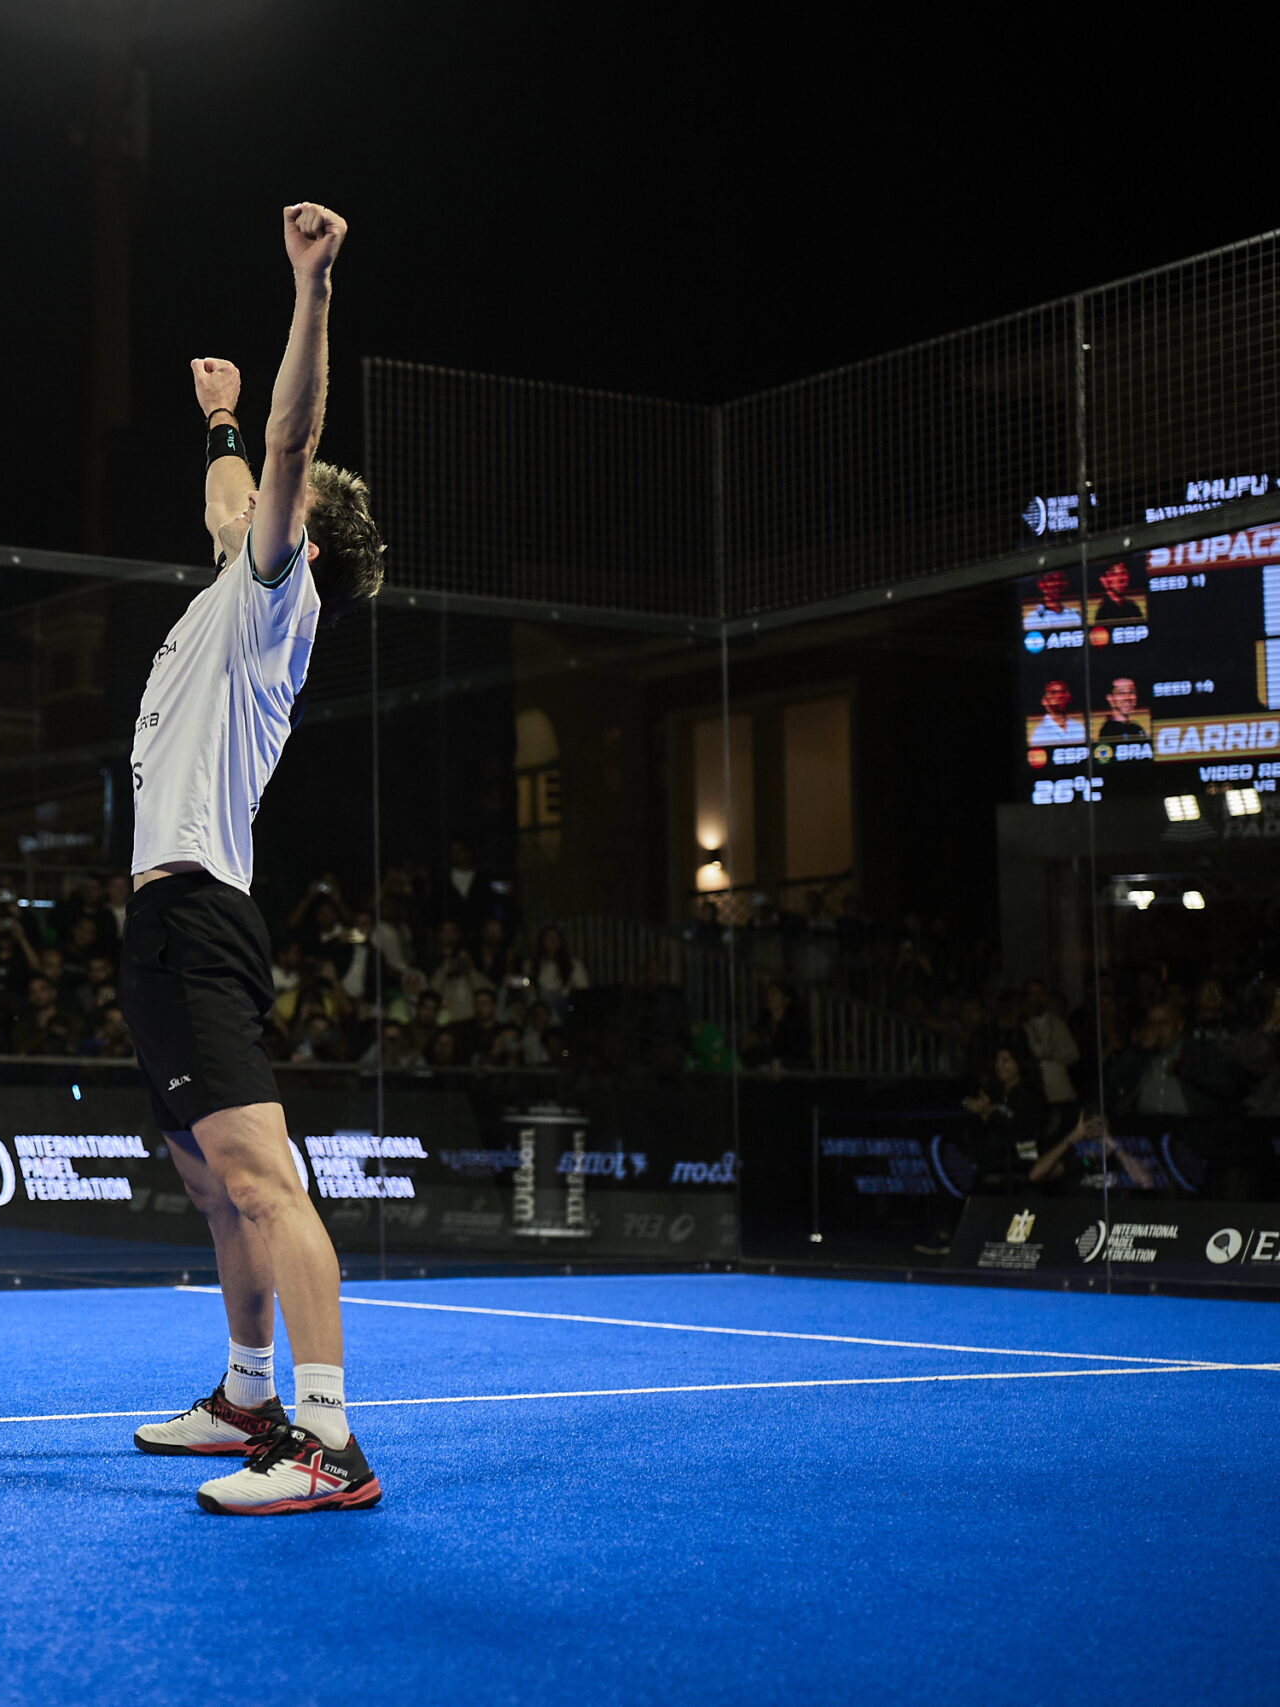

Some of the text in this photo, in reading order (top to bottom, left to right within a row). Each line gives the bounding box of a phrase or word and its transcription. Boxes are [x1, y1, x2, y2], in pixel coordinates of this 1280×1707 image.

[1149, 575, 1188, 592] SEED
[1112, 625, 1149, 644] ESP
[1153, 681, 1192, 697] SEED
[1052, 747, 1090, 765] ESP
[1115, 743, 1154, 761] BRA
[1199, 763, 1254, 782] VIDEO
[14, 1135, 150, 1159] INTERNATIONAL
[20, 1157, 79, 1179] PADEL
[311, 1157, 365, 1178] PADEL
[24, 1177, 132, 1200] FEDERATION
[1111, 1223, 1179, 1239] INTERNATIONAL
[324, 1463, 349, 1478] STUPA
